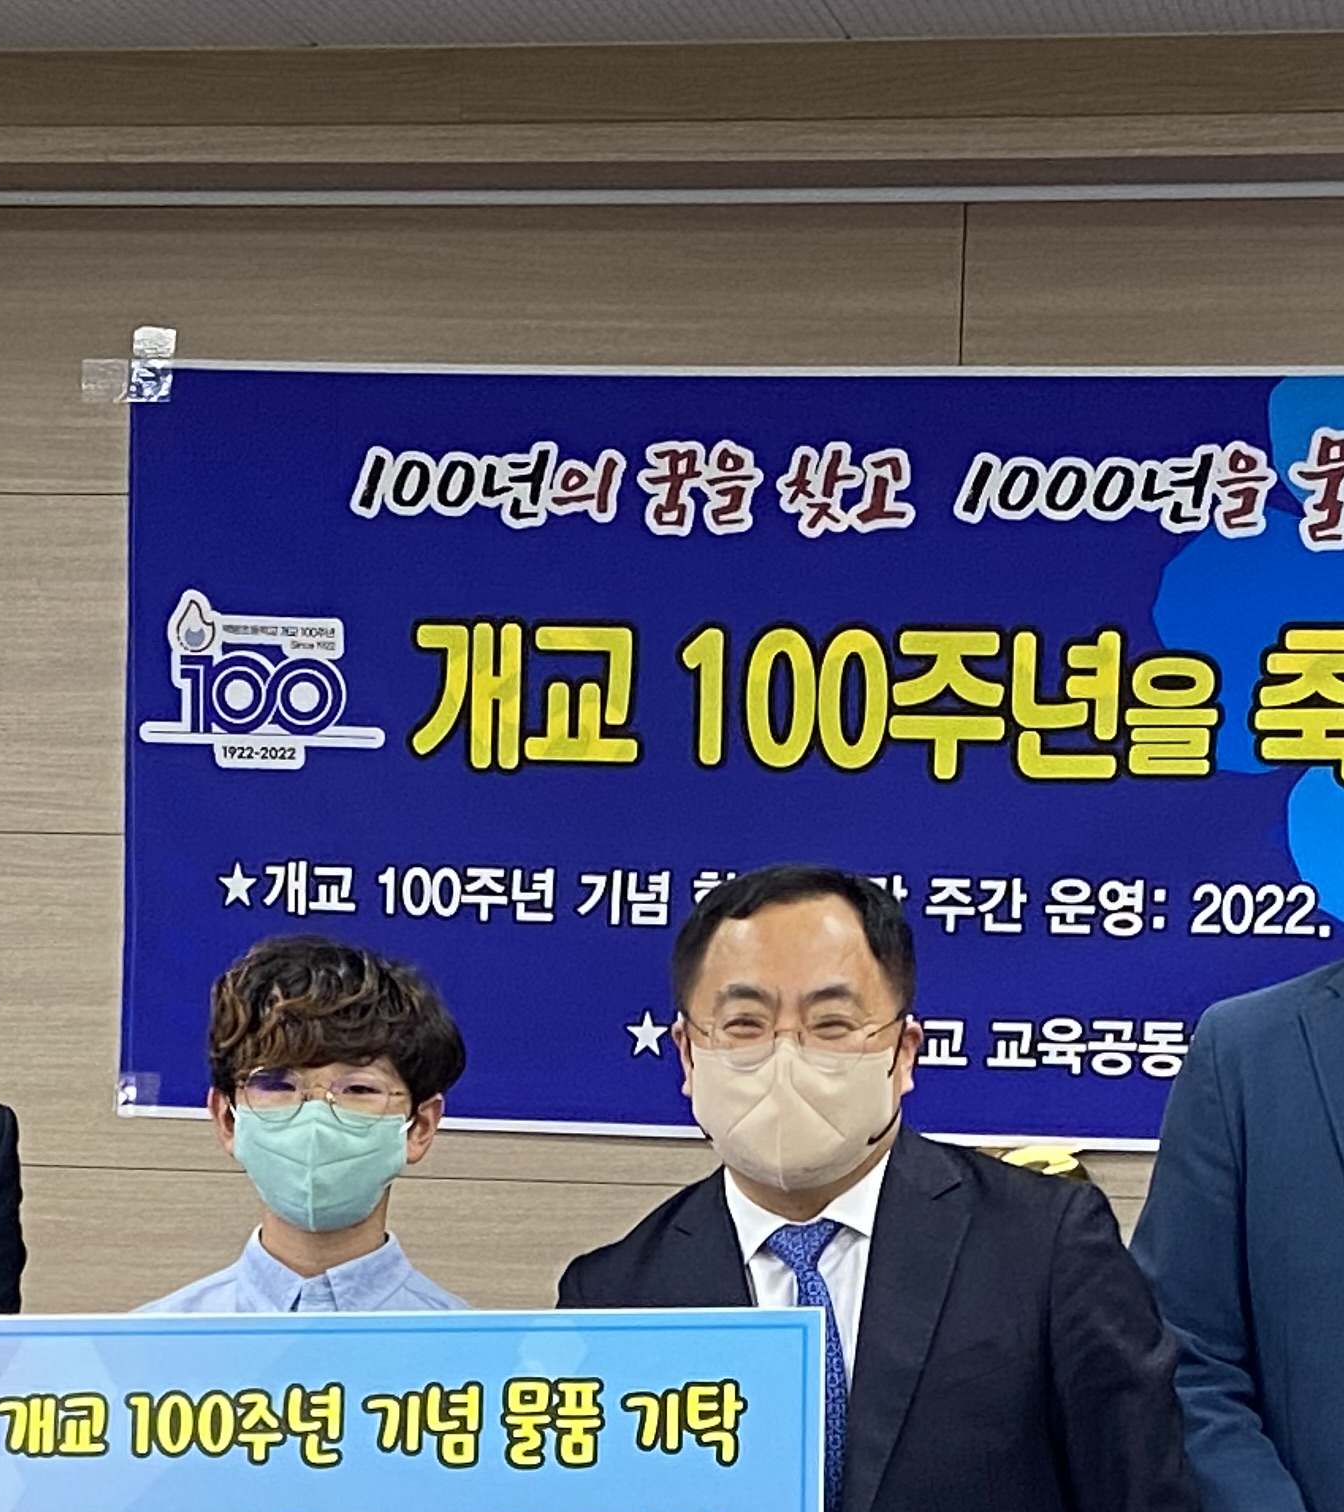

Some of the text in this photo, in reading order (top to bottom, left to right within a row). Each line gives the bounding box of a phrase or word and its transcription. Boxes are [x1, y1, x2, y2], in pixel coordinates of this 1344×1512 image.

[358, 446, 620, 522] 100년의
[648, 446, 756, 530] 꿈을
[784, 449, 910, 532] 찾고
[961, 448, 1268, 530] 1000년을
[411, 621, 640, 769] 개교
[682, 624, 1219, 782] 100주년을
[221, 746, 297, 761] 1922-2022
[264, 861, 356, 916] 개교
[376, 866, 556, 923] 100주년
[578, 869, 671, 926] 기념
[925, 879, 1028, 934] 주간
[1043, 879, 1169, 936] 운영:
[1191, 883, 1333, 938] 2022.
[986, 1017, 1196, 1078] 교육공동
[128, 1384, 345, 1465] 100주년
[367, 1385, 482, 1465] 기념
[502, 1377, 605, 1467] 물품
[625, 1380, 747, 1465] 기탁
